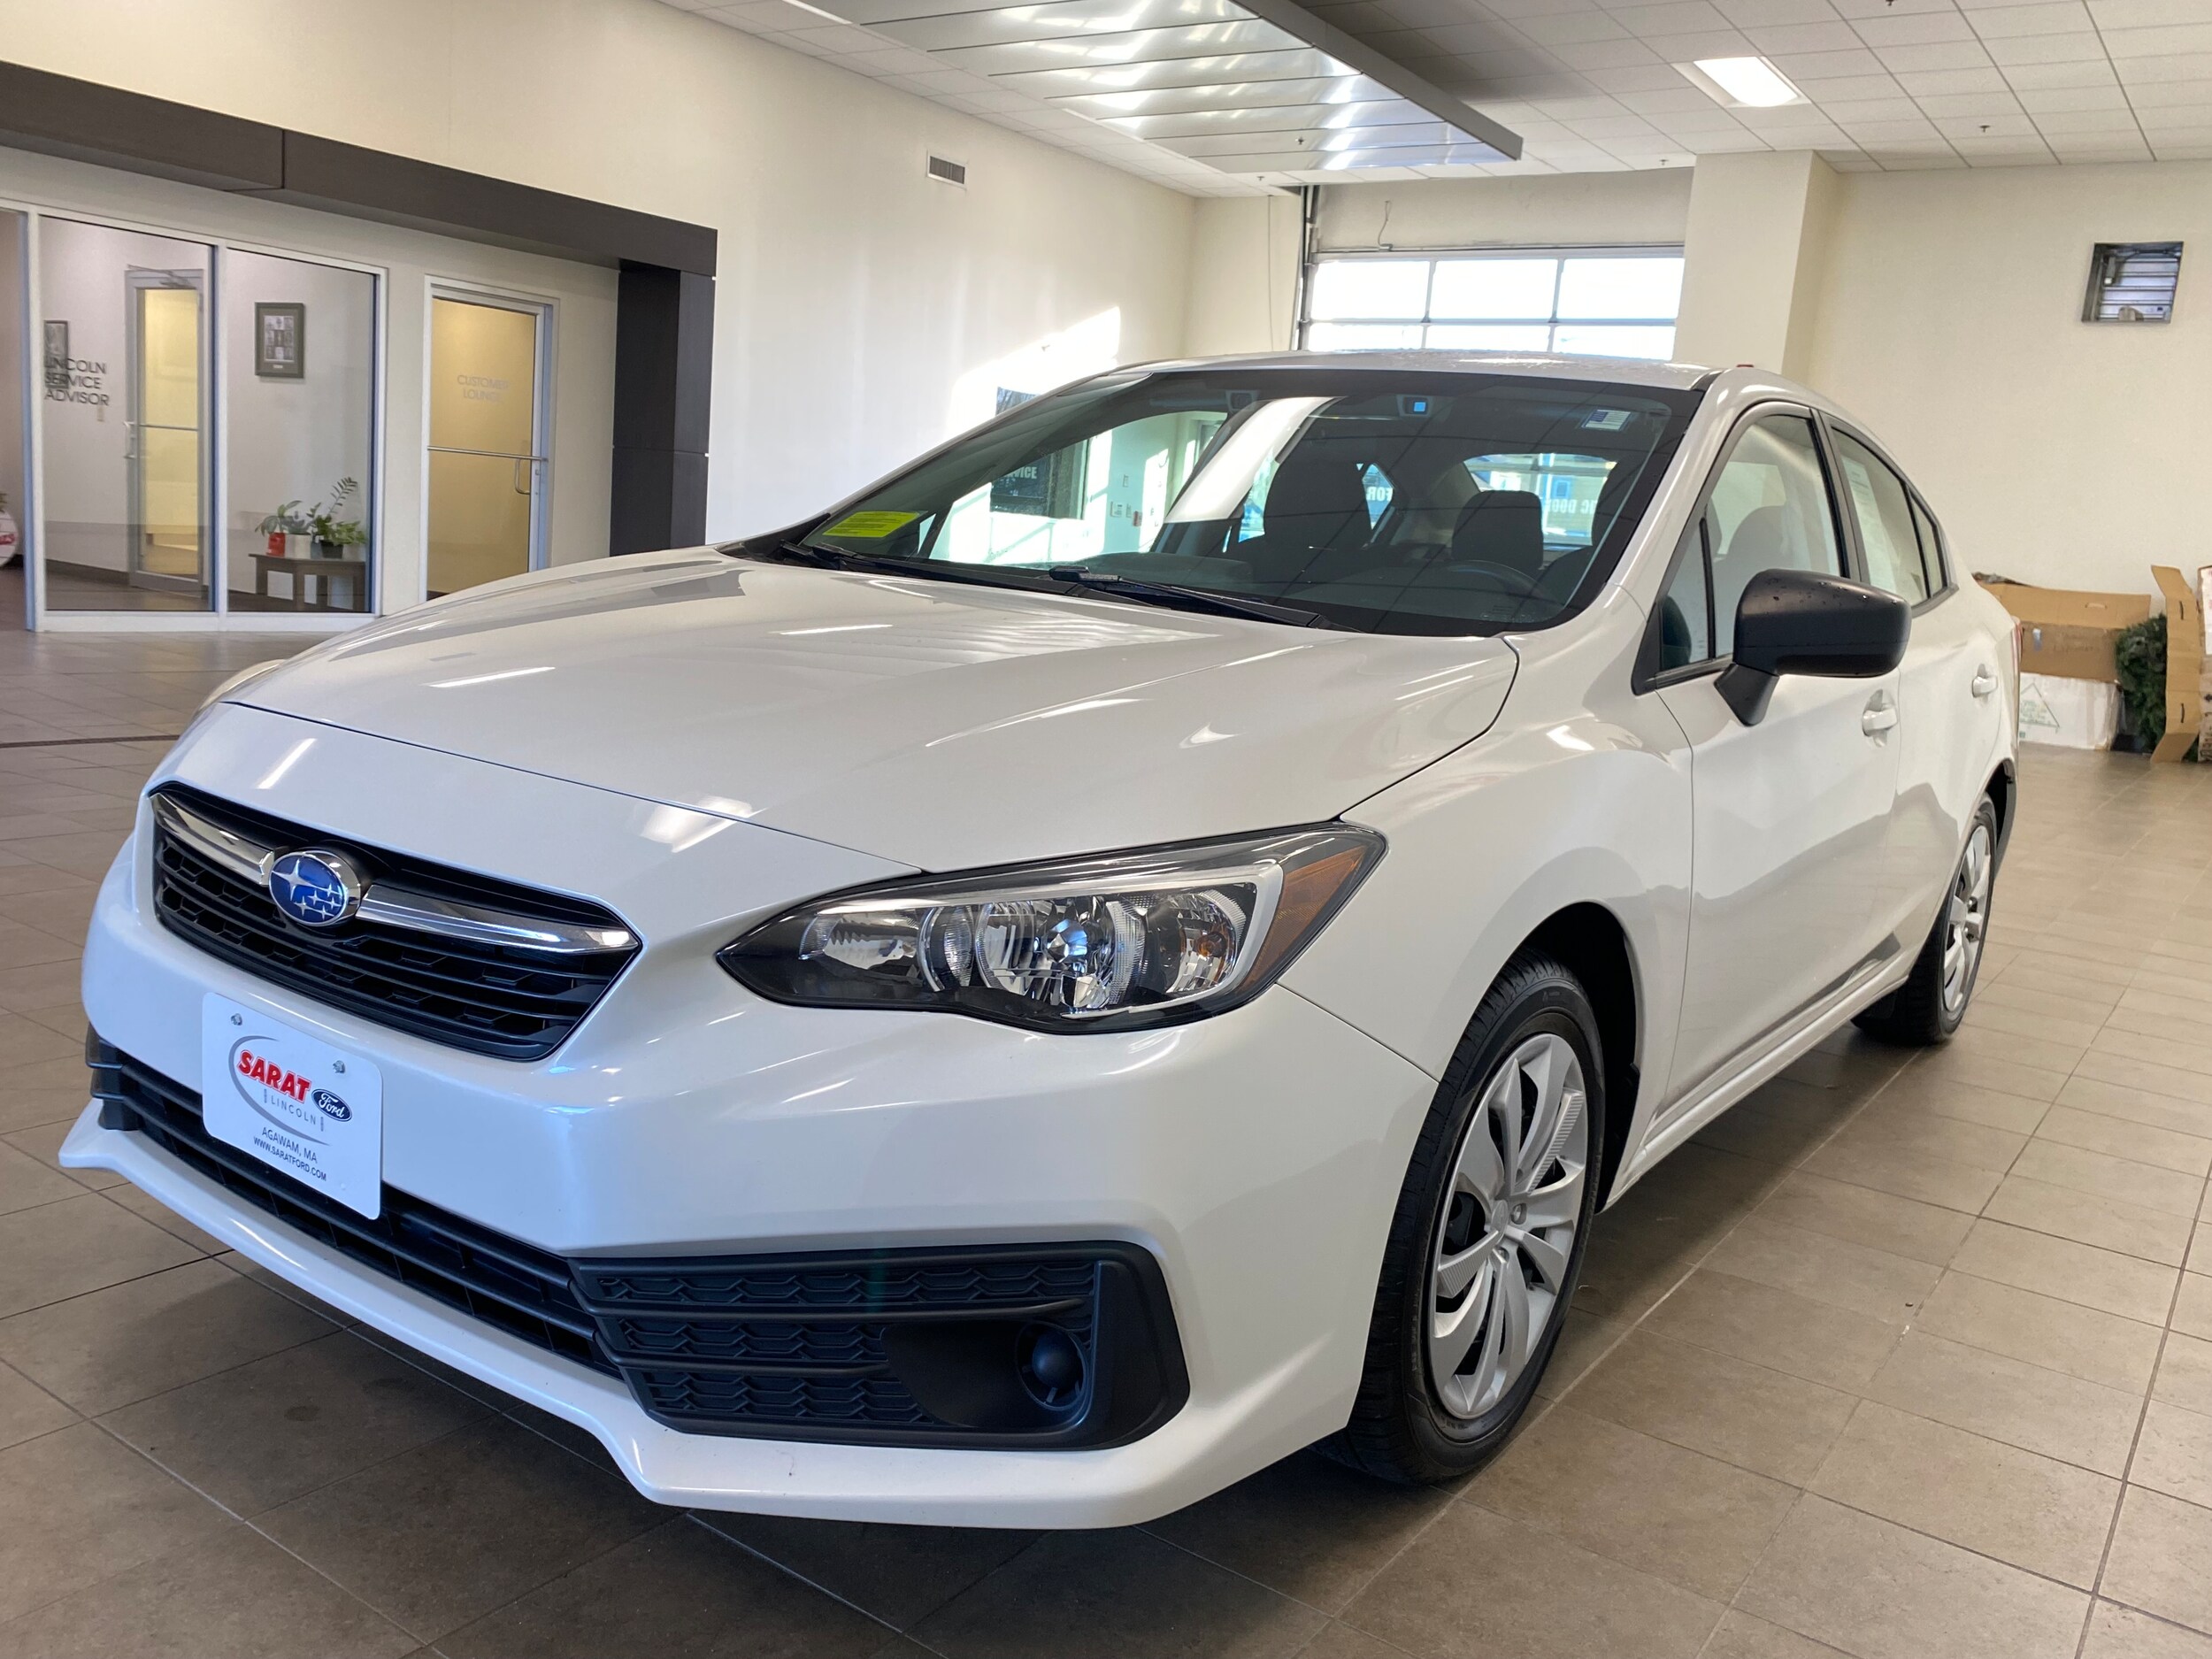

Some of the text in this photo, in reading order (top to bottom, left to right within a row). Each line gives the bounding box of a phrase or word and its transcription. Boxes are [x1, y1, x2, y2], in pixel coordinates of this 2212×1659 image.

[44, 357, 106, 374] LINCOLN
[45, 372, 102, 389] SERVICE
[457, 374, 510, 390] CUSTOMER
[44, 389, 110, 406] ADVISOR
[463, 388, 502, 402] LOUNG
[1005, 466, 1038, 480] VICE
[237, 1049, 311, 1103] SARAT
[271, 1095, 316, 1125] LINCOLN
[319, 1093, 345, 1118] Ford
[262, 1127, 318, 1164] AGAWAM, MA
[253, 1136, 326, 1181] WWW.SARATFORD.COM
